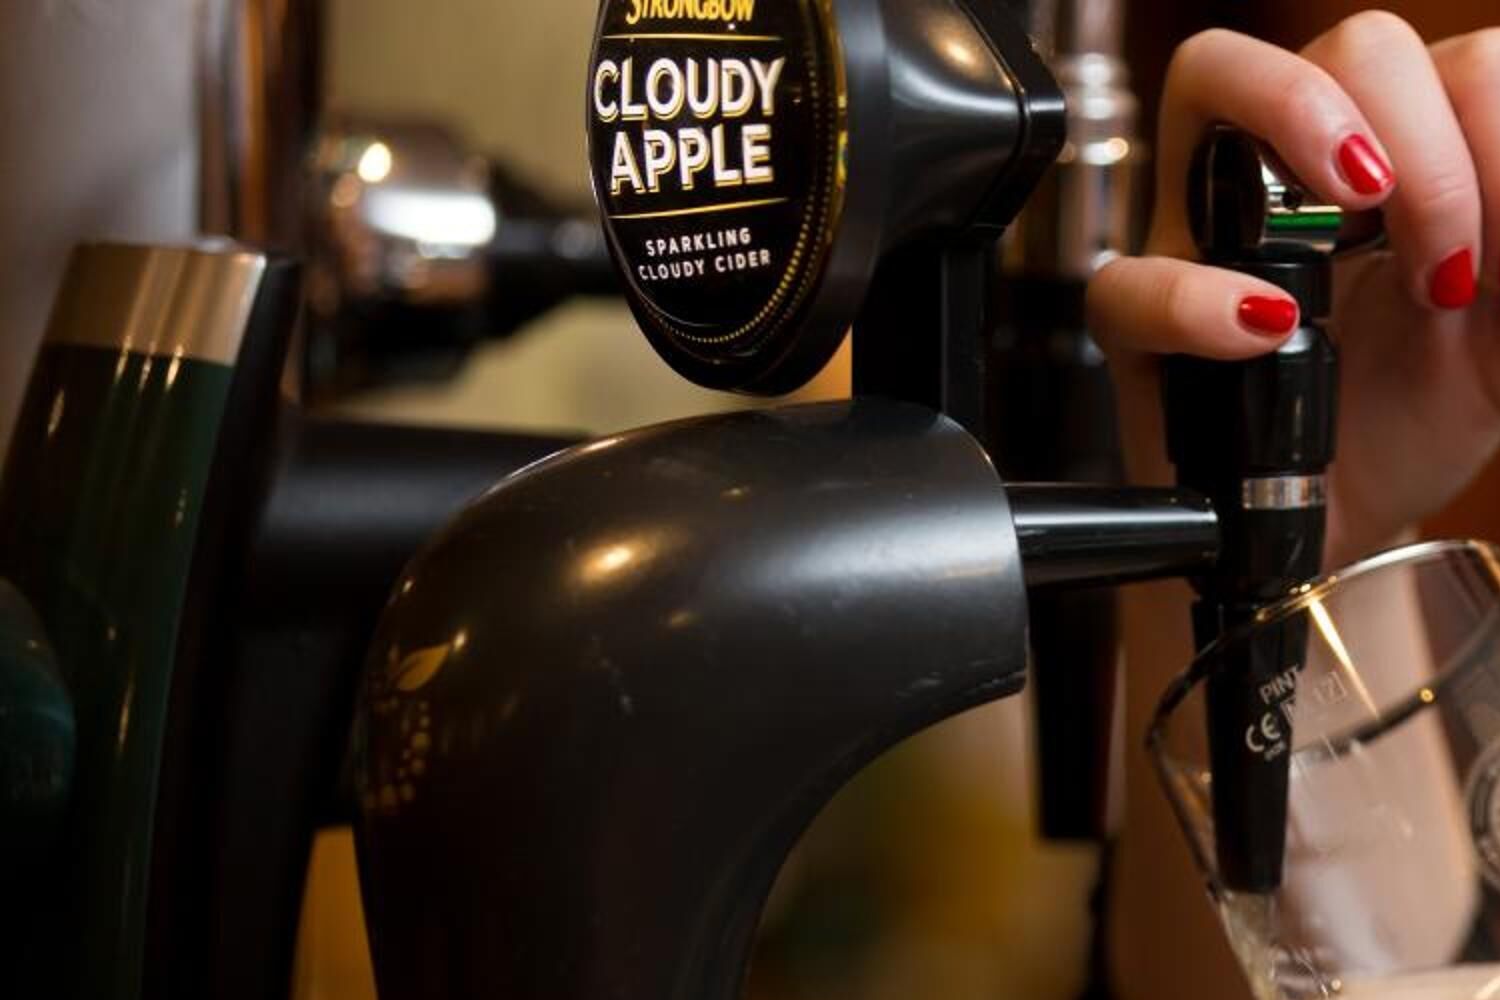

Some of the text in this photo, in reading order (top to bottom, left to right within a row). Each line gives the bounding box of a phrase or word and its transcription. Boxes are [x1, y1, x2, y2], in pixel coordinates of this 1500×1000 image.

[594, 56, 785, 122] CLOUDY
[610, 124, 774, 195] APPLE
[638, 248, 771, 281] CLOUDY CIDER
[645, 227, 751, 257] SPARKLING
